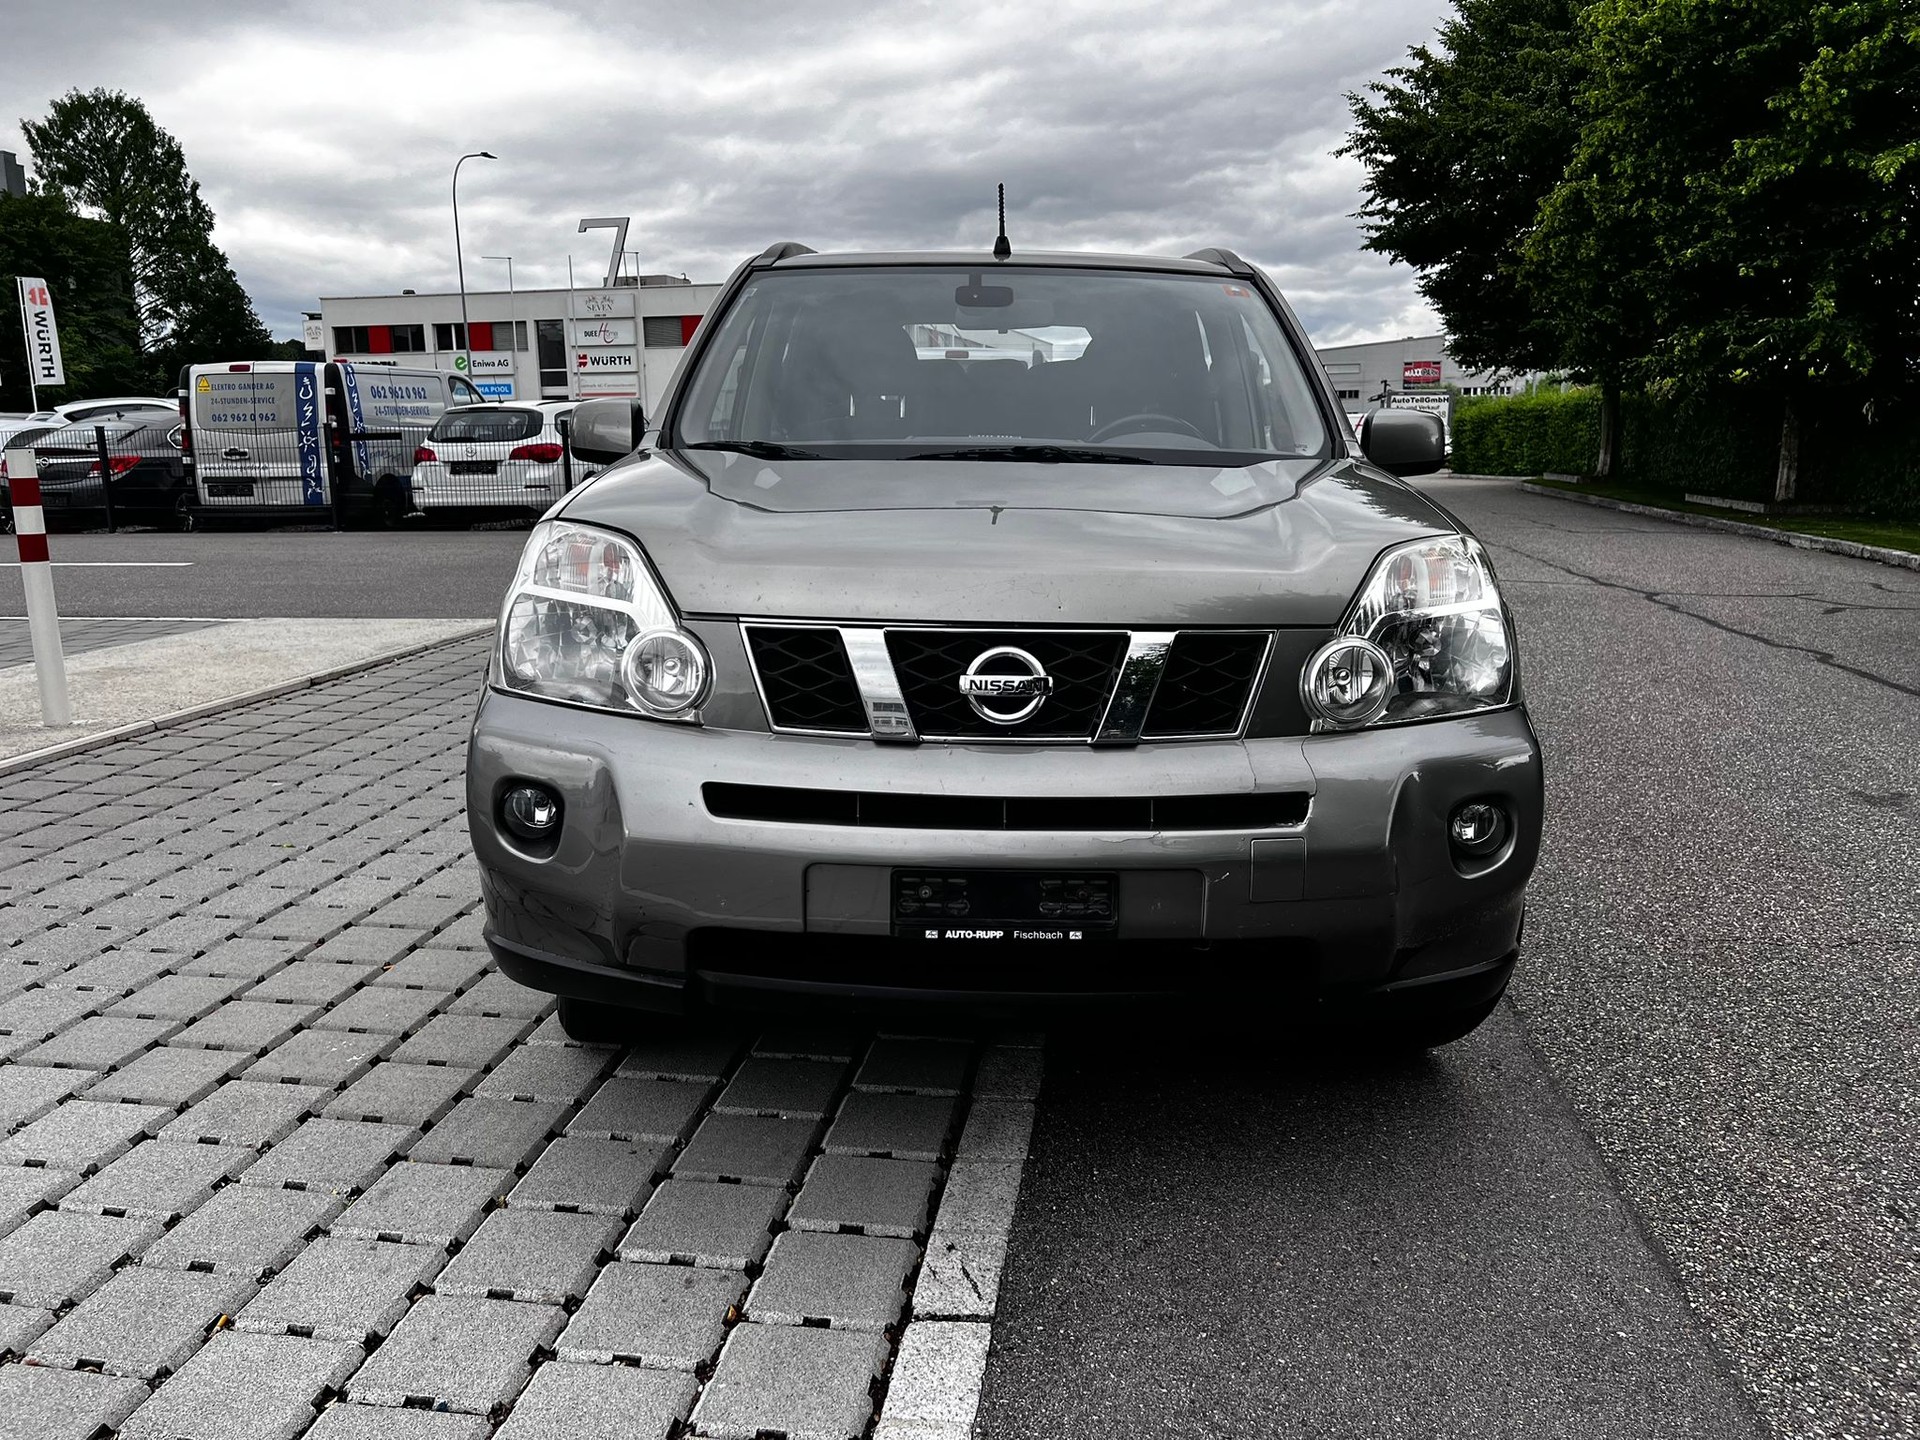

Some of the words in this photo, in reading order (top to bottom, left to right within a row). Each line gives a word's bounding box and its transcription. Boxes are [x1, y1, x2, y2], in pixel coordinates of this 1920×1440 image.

[34, 311, 56, 378] WÜRTH
[472, 360, 495, 368] Eniwa
[497, 359, 509, 367] AG
[590, 355, 631, 366] WÜRTH
[211, 383, 236, 391] ELEKTRO
[265, 382, 275, 390] AG
[370, 385, 388, 399] 062
[388, 386, 404, 399] 962
[405, 386, 411, 399] 0
[412, 386, 427, 399] 962
[211, 413, 228, 422] 062
[230, 413, 247, 422] 962
[249, 413, 256, 422] 0
[258, 412, 276, 422] 962
[969, 679, 1046, 692] NISSAN
[945, 930, 1004, 939] AUTO-RUPP
[1013, 930, 1063, 939] Fischbach
